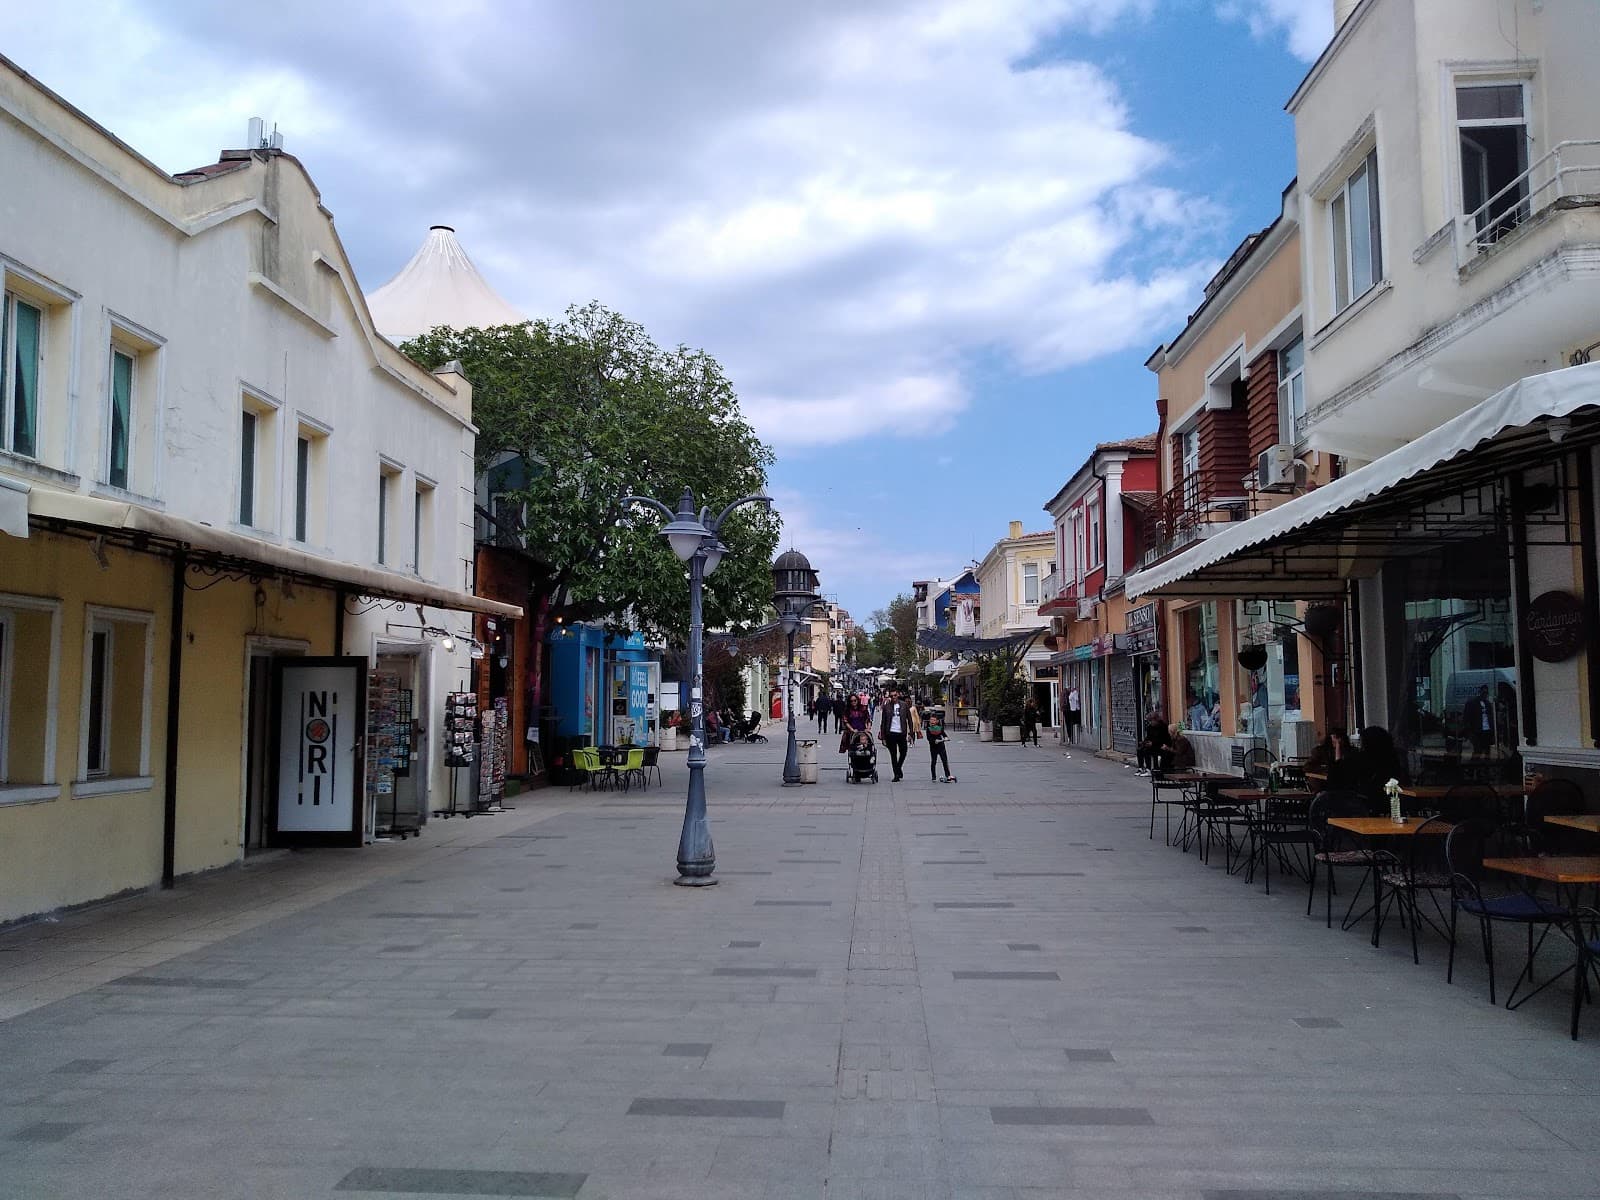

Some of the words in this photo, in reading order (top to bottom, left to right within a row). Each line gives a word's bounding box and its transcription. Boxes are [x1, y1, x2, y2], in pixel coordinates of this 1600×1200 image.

[1133, 606, 1150, 625] SENSO
[631, 689, 648, 709] GOOD
[306, 690, 331, 806] NORI
